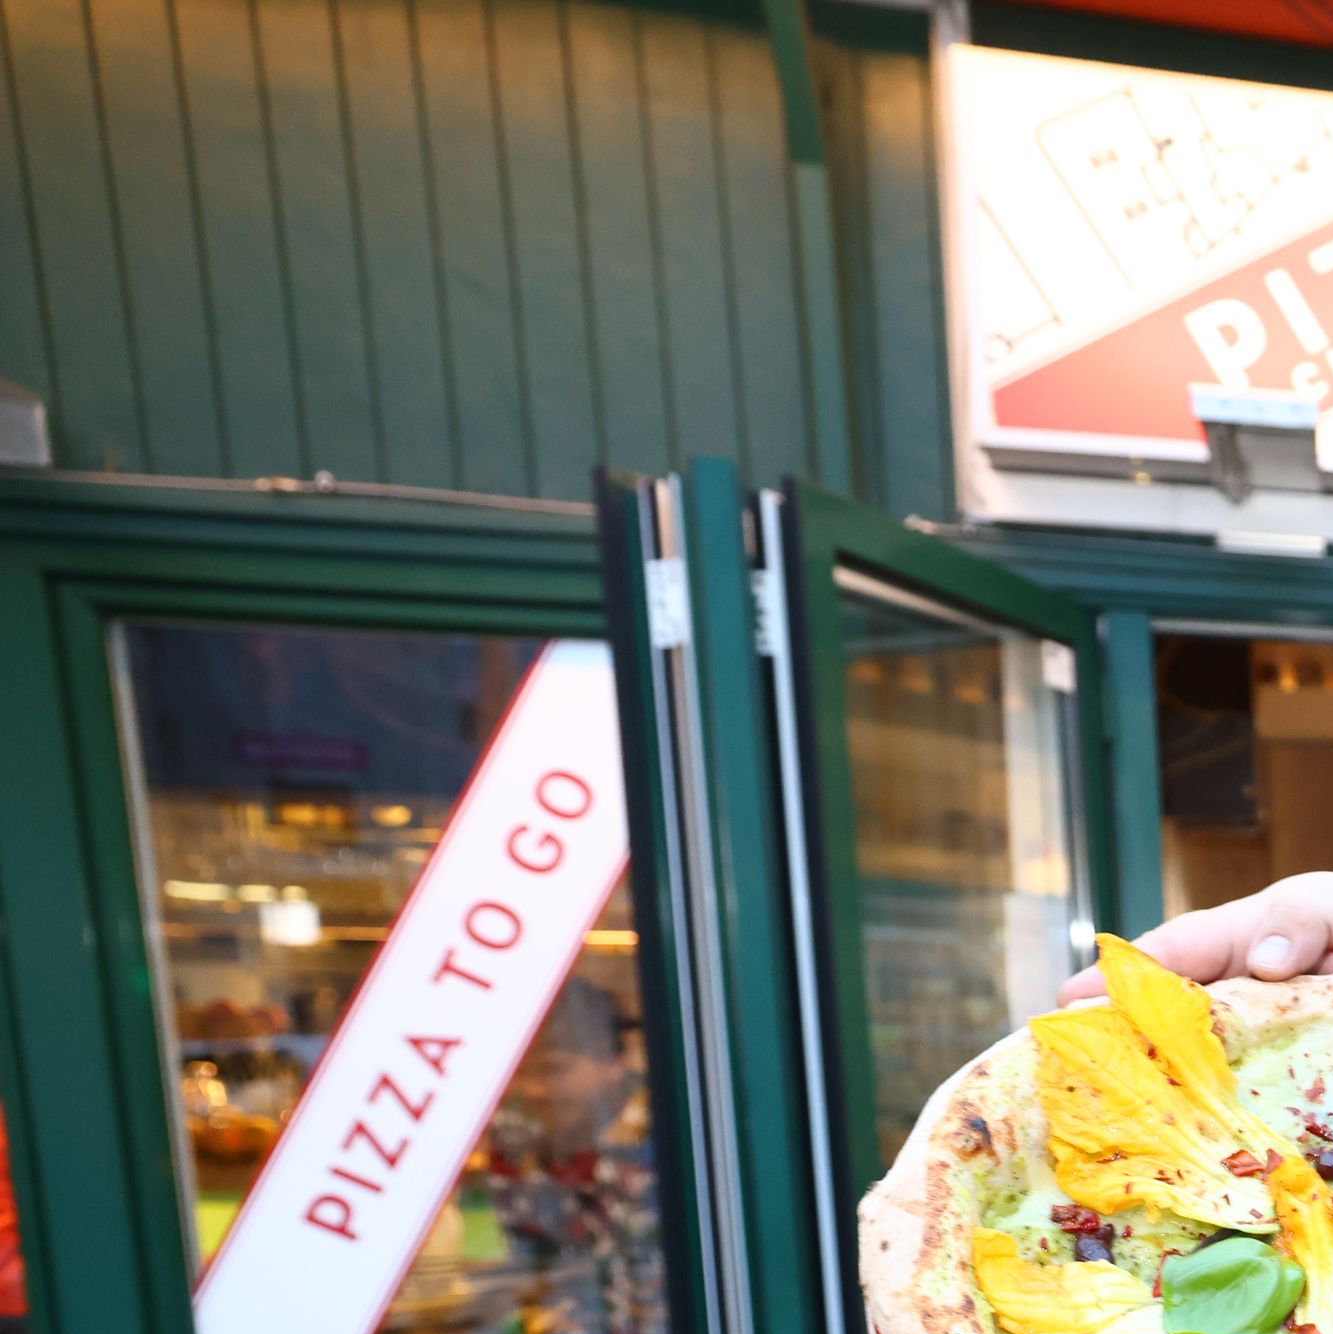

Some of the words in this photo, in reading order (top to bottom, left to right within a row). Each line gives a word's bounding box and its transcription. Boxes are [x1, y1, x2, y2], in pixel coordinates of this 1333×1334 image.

[302, 1031, 464, 1242] PIZZA
[432, 900, 525, 993] TO
[507, 769, 594, 875] GO
